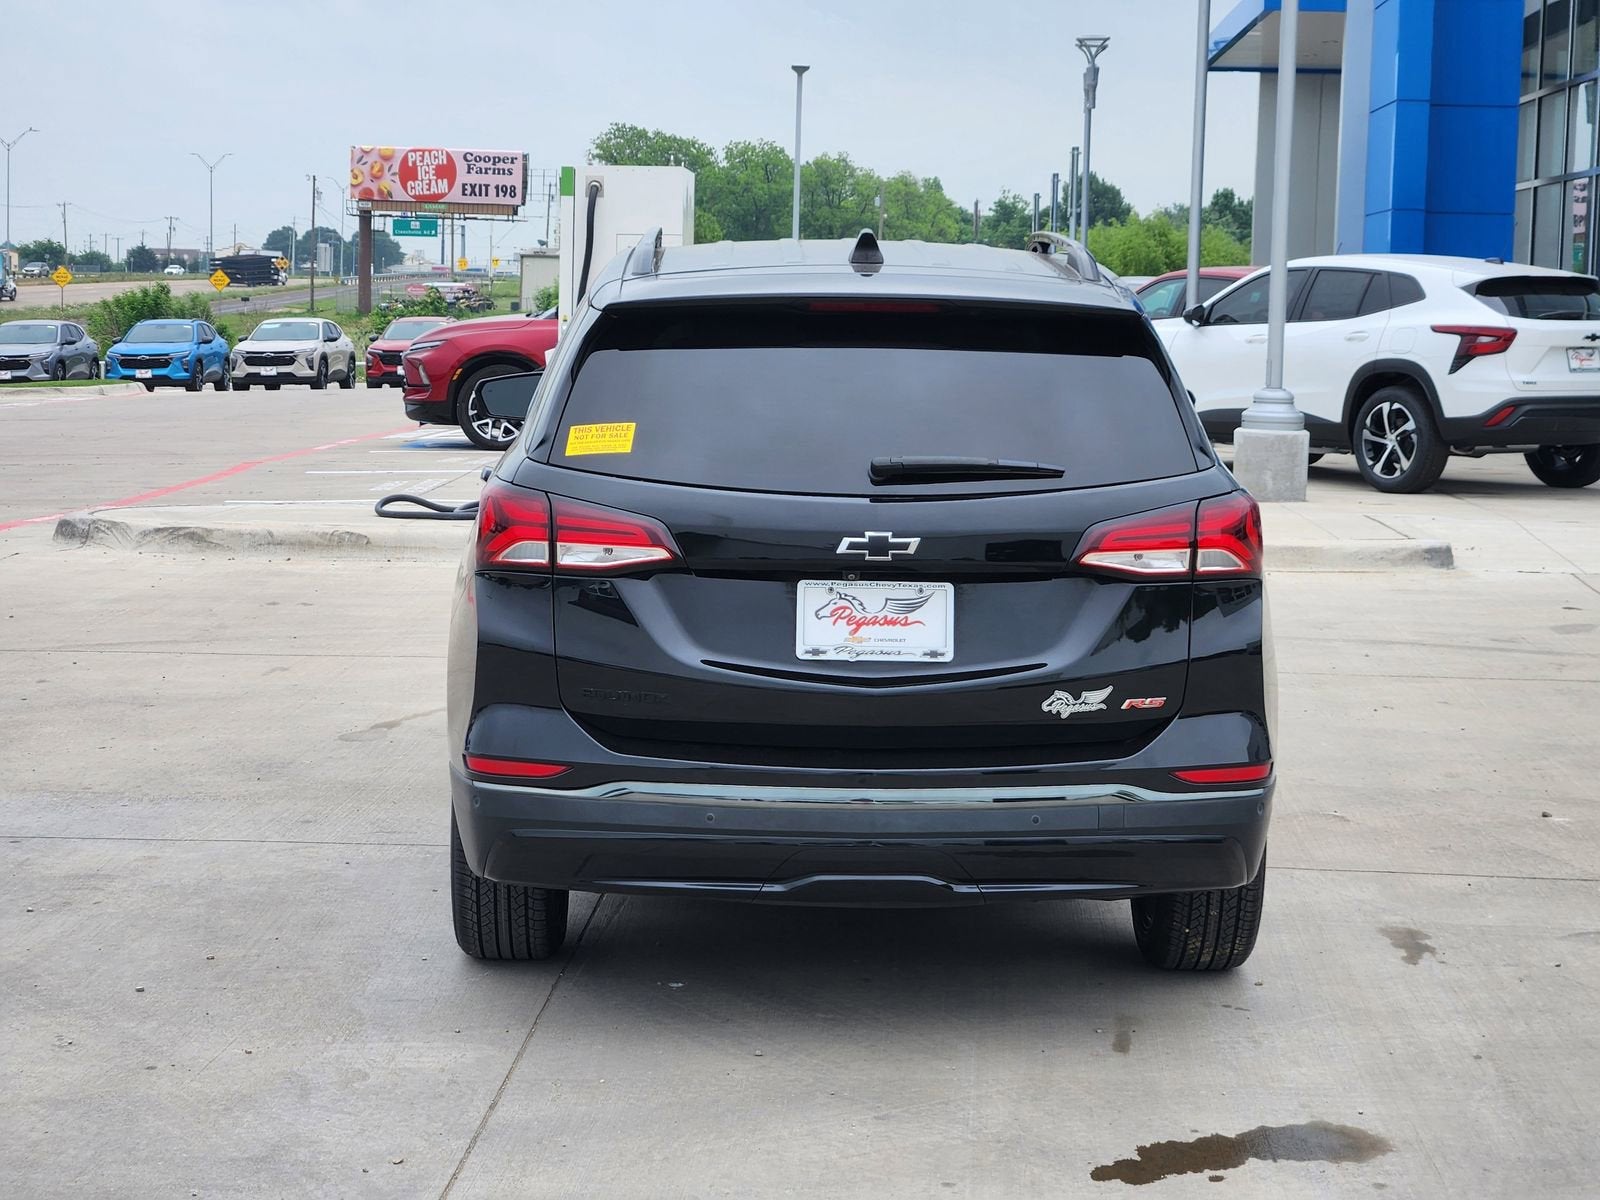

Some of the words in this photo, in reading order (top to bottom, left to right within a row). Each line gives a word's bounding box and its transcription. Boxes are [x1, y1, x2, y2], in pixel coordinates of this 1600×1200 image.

[407, 150, 447, 167] PEACH
[463, 152, 518, 166] Cooper
[417, 165, 437, 180] ICE
[466, 163, 514, 176] Farms
[407, 178, 449, 196] CREAM
[461, 183, 491, 198] EXIT
[494, 184, 517, 199] 198
[595, 424, 632, 433] VEHICLE
[804, 581, 946, 589] www.PegasusChevyTexas.com
[830, 605, 926, 636] Pegasus
[834, 646, 917, 660] Pegasus
[1051, 699, 1108, 720] Pegasus
[1120, 697, 1167, 710] RS
